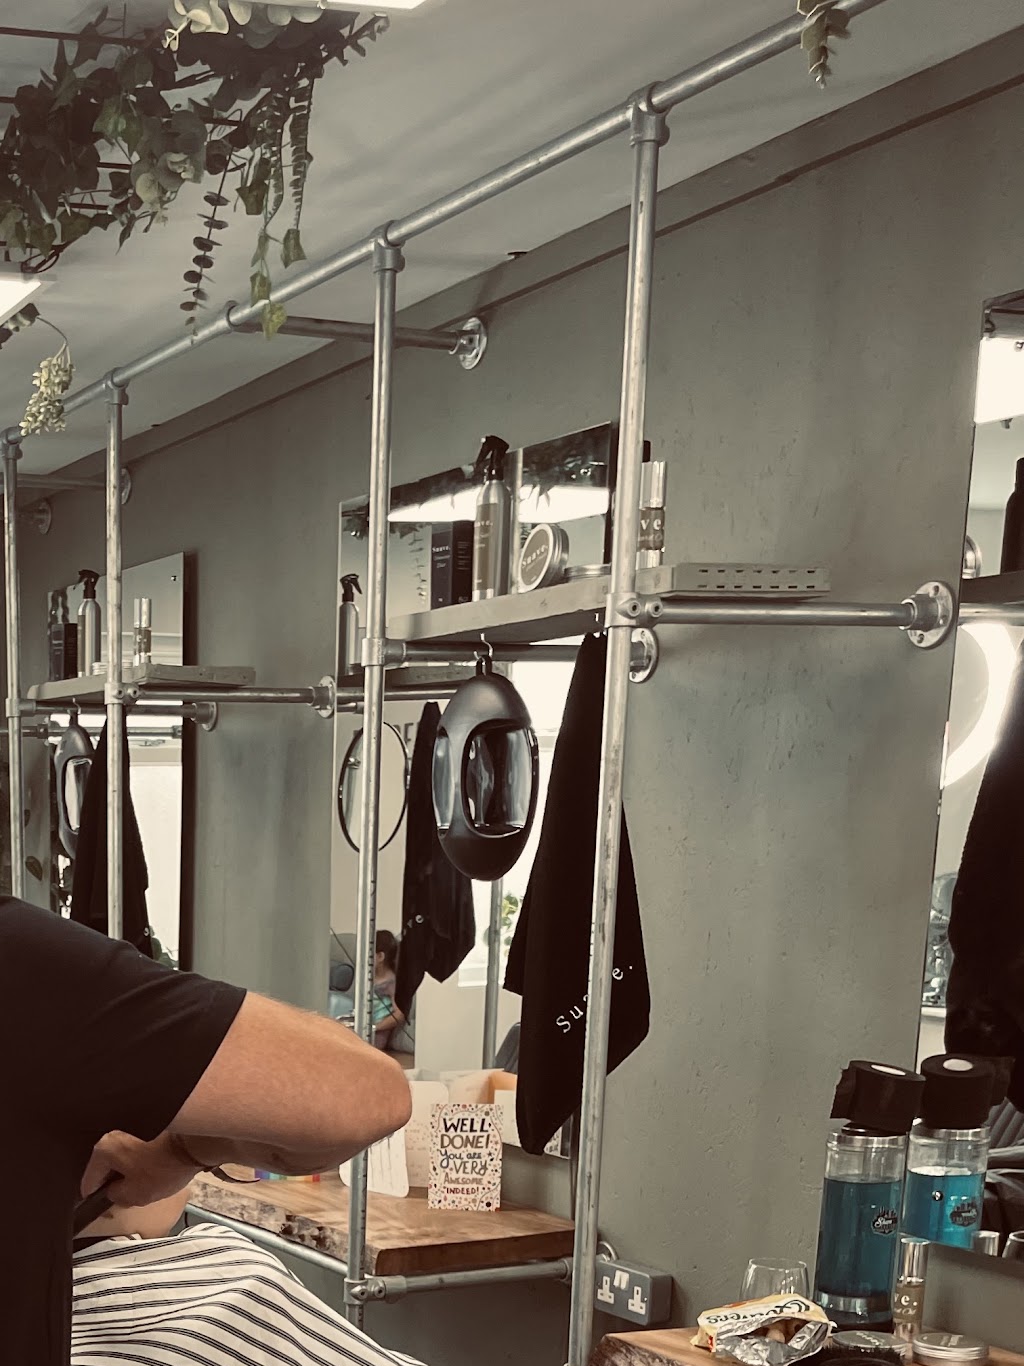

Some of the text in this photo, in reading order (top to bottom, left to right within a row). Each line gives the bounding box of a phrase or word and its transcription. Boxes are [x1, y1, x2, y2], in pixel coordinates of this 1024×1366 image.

[556, 966, 633, 1033] Sue.
[443, 1118, 489, 1133] WELL
[440, 1133, 490, 1149] DONE!
[446, 1186, 479, 1195] INDEED!
